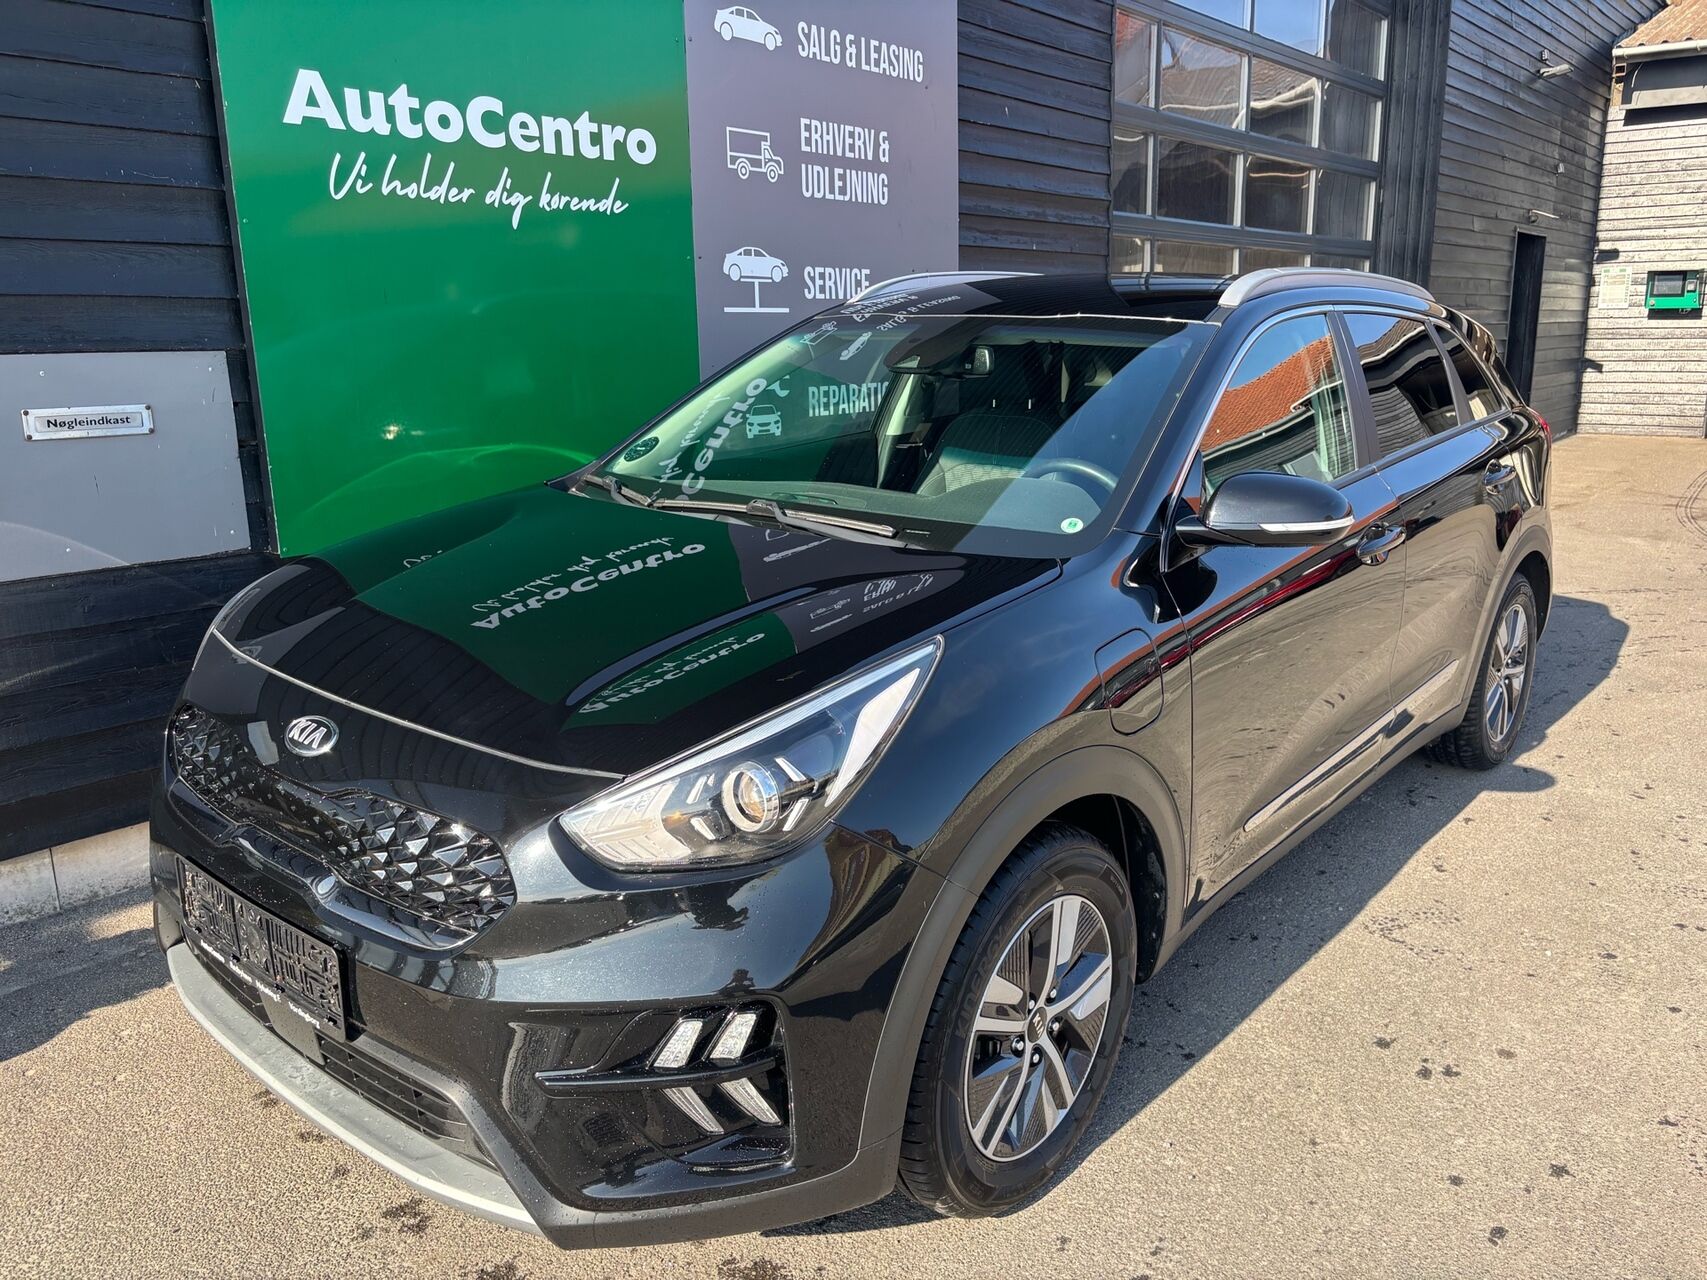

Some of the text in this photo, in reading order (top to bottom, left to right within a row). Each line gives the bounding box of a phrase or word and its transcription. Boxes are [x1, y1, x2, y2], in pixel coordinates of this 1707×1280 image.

[797, 21, 923, 83] SALG & LEASING
[282, 68, 657, 165] AutoCentro
[800, 117, 890, 163] ERHVERV &
[328, 151, 630, 230] Vi holder dig kørende
[801, 163, 889, 206] UDLEJNING
[803, 266, 871, 300] SERVICE
[46, 415, 131, 430] Nøgleindkast
[288, 719, 328, 750] KIA
[1032, 1012, 1045, 1039] KIA
